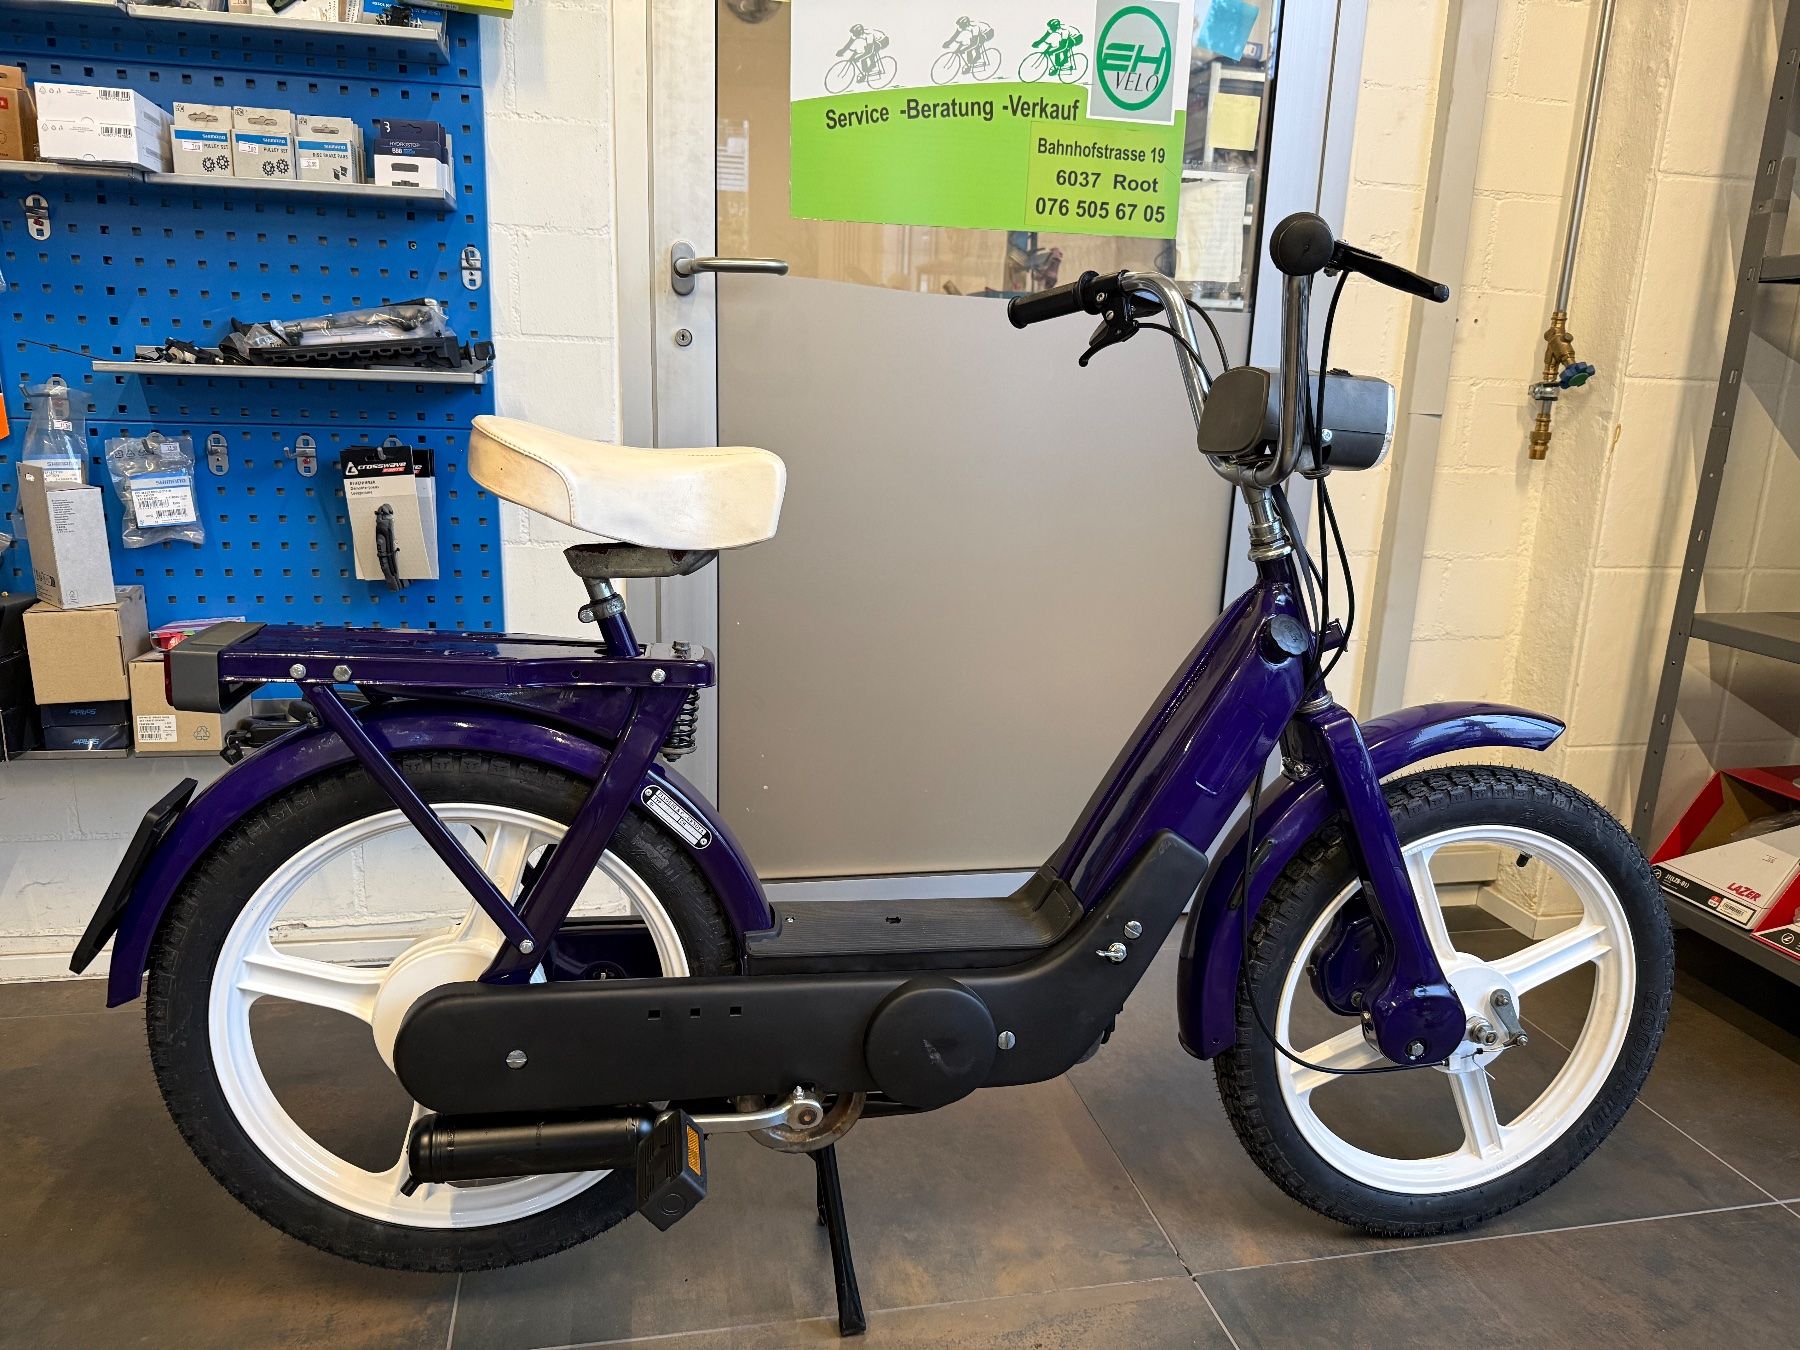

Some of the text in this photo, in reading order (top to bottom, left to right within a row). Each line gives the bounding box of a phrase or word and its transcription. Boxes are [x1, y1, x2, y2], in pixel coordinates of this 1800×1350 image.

[1116, 72, 1159, 91] VELO
[825, 95, 1079, 129] Service -Beratung -Verkauf
[1038, 137, 1165, 163] Bahnhofstrasse 19
[1056, 169, 1158, 193] 6037 Root
[1036, 197, 1165, 223] 076 505 67 05
[358, 462, 406, 470] crosswave
[1727, 882, 1761, 901] LAZER
